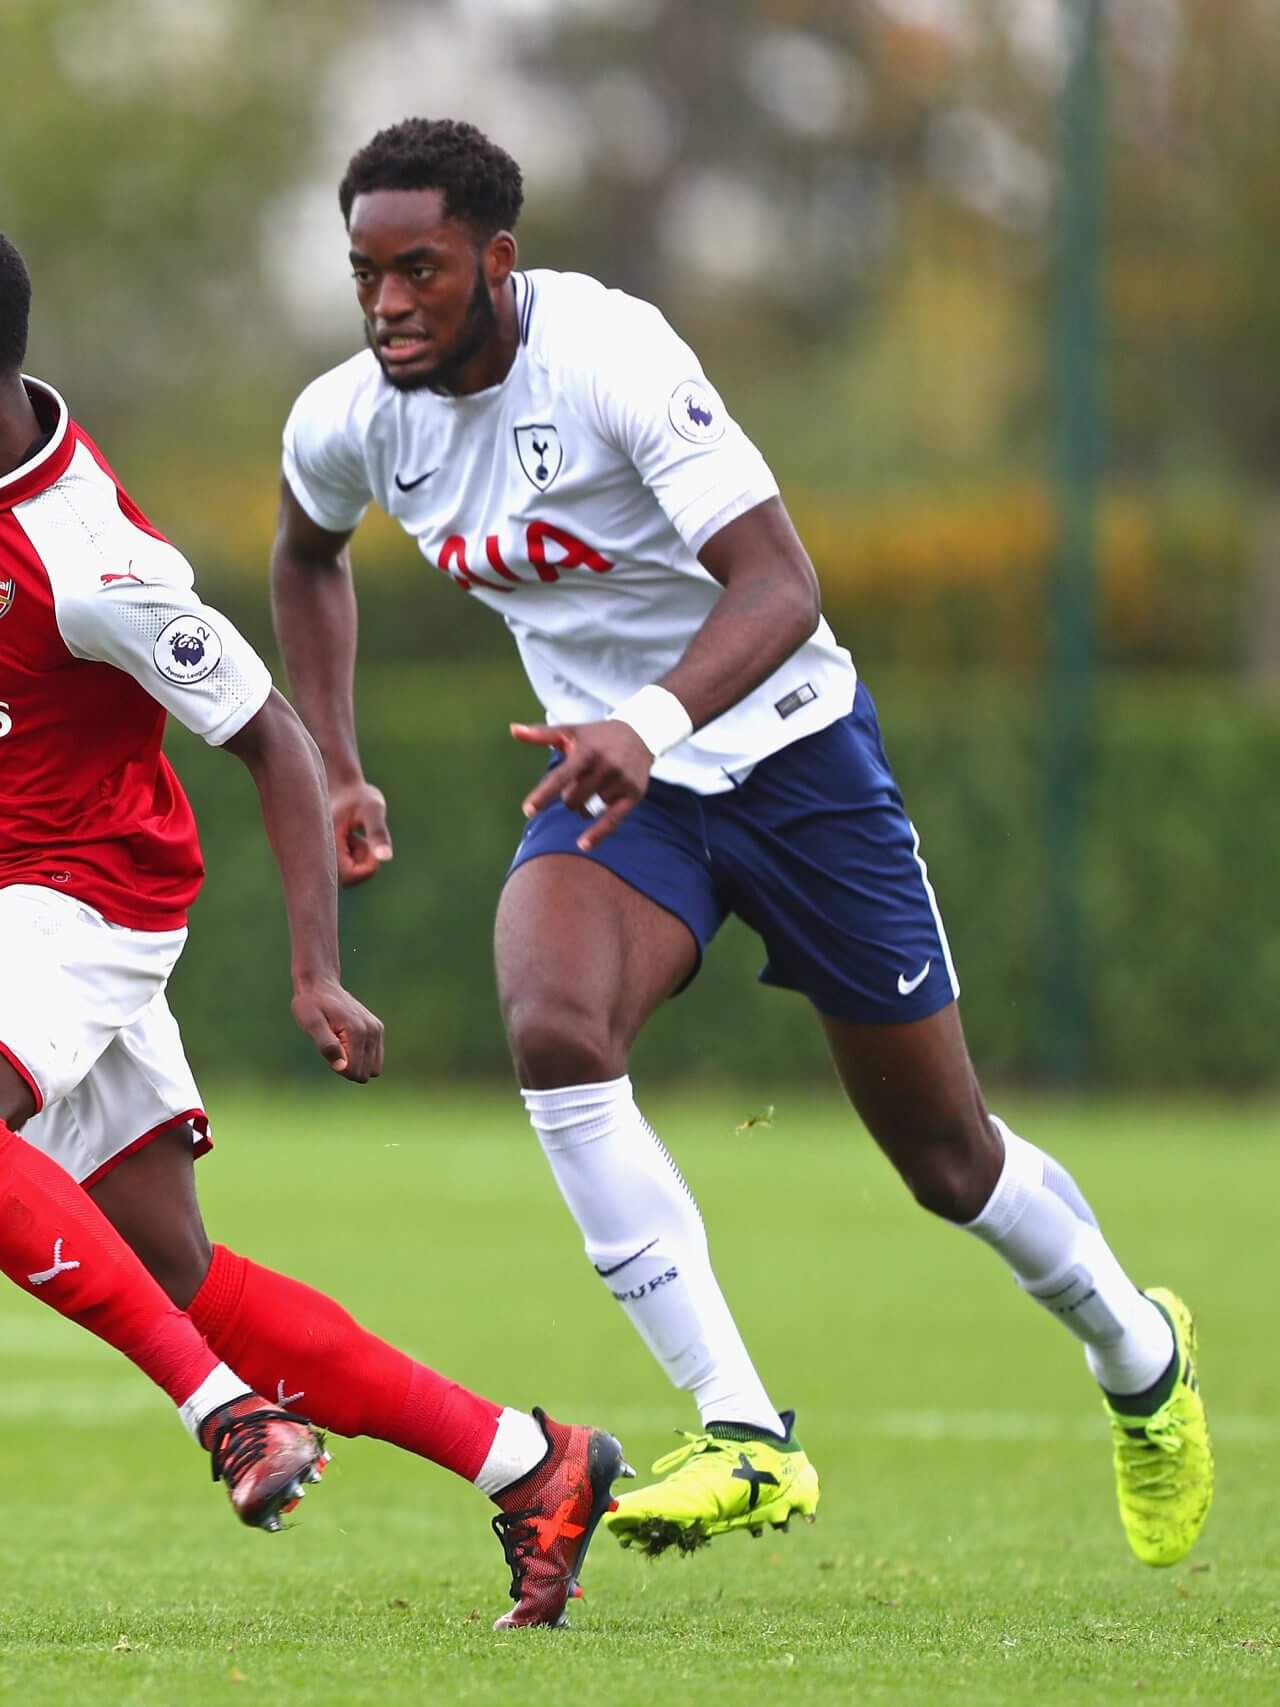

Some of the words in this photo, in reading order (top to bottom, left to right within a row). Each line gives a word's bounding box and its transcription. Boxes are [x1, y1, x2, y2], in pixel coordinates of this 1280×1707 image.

[437, 520, 615, 592] AIA
[196, 626, 210, 641] 2
[611, 1265, 679, 1302] PURS
